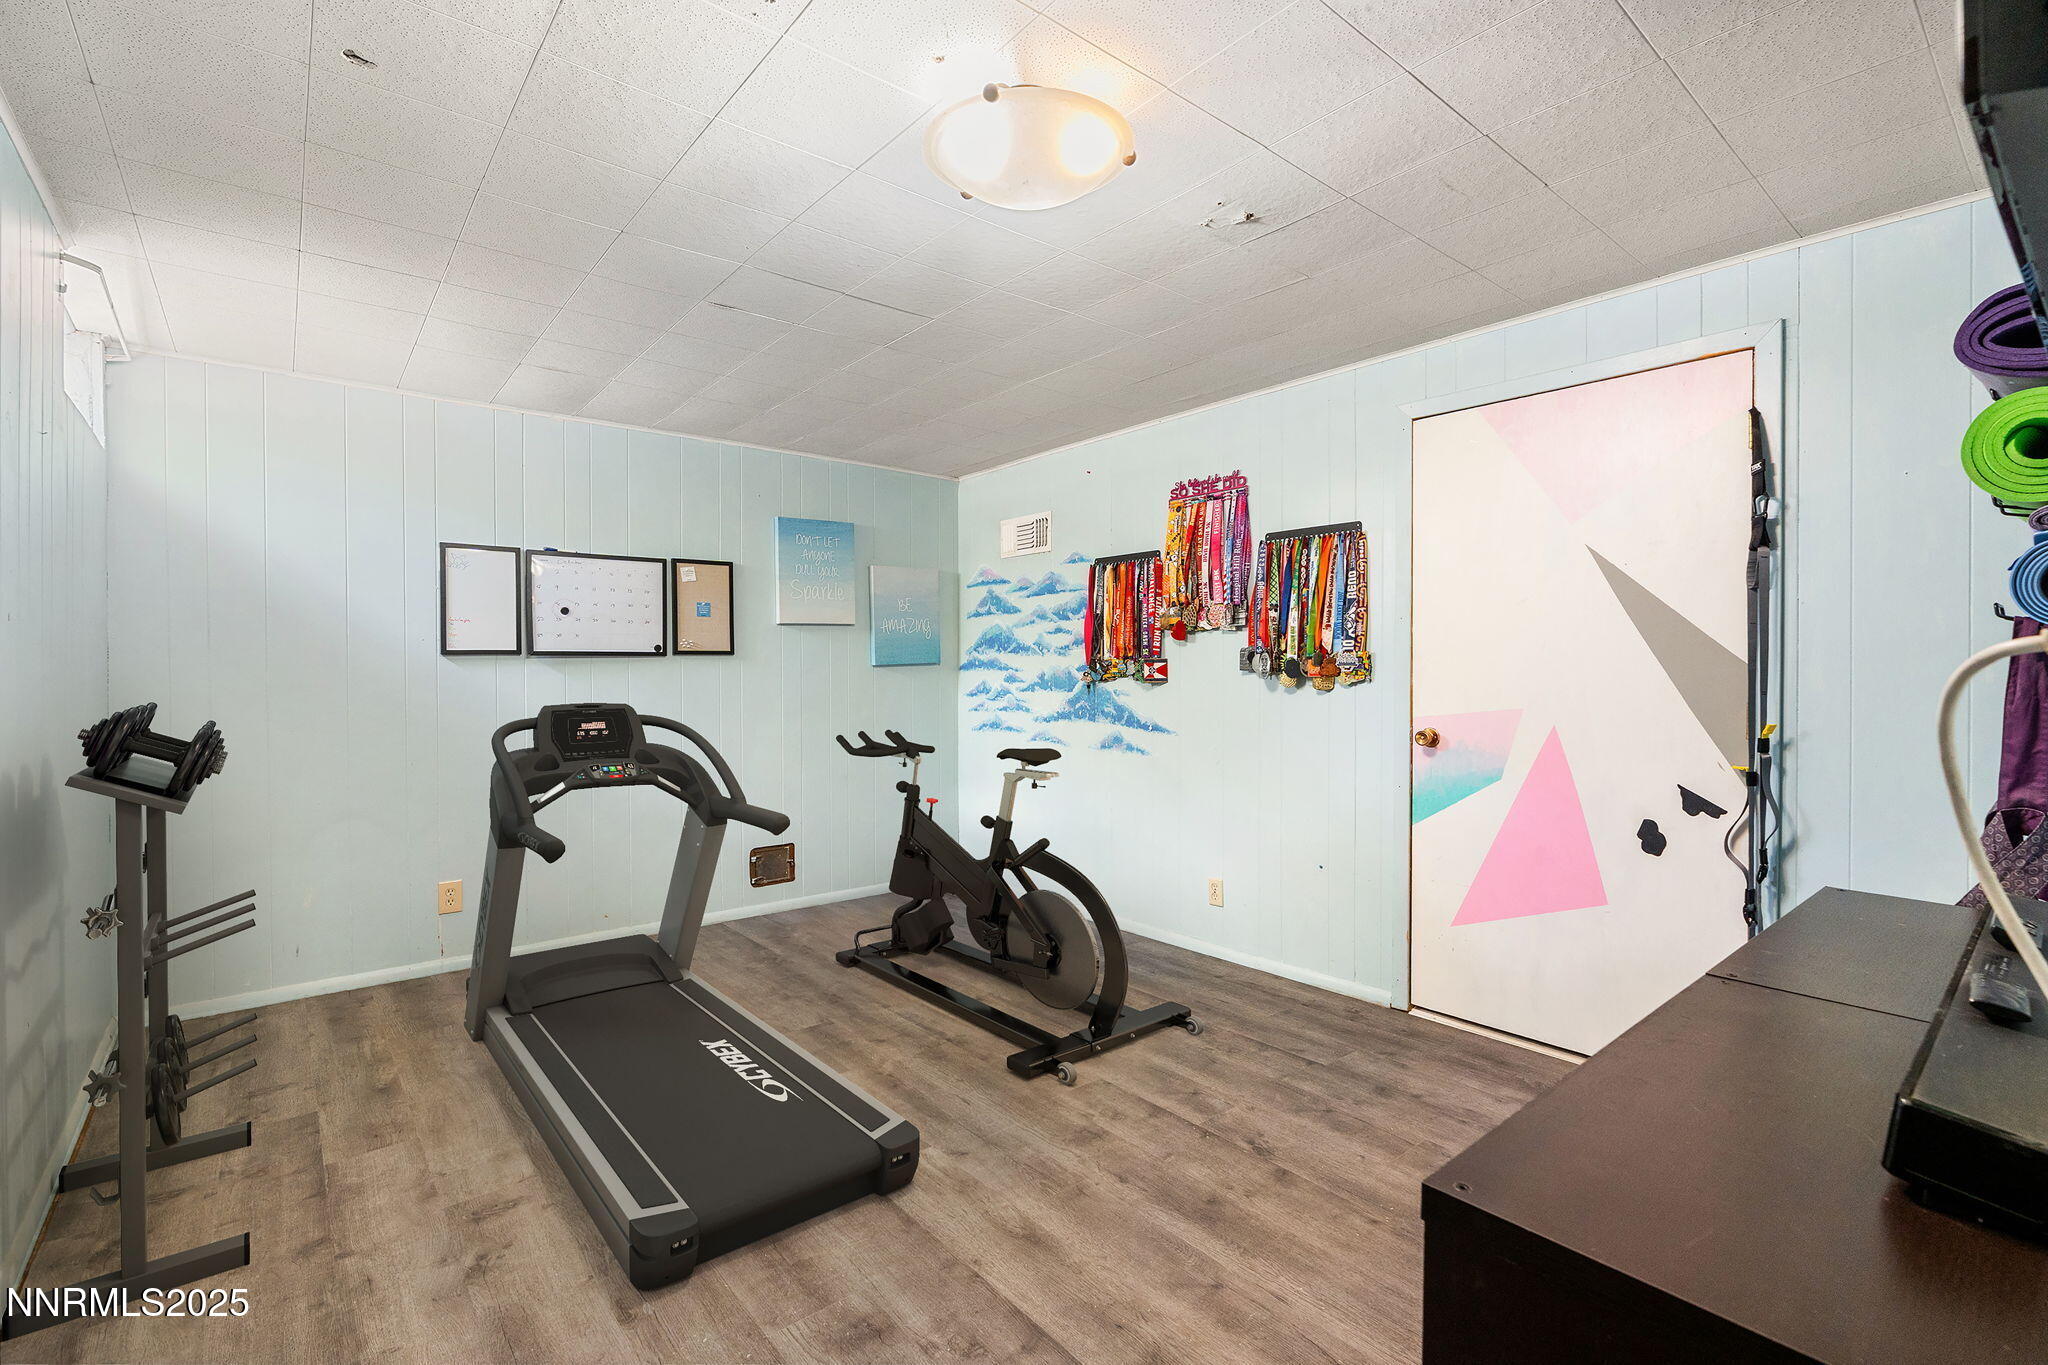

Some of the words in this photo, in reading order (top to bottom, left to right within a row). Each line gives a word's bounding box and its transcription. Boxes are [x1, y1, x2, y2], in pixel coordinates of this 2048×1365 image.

[1170, 488, 1188, 498] SO
[1192, 481, 1218, 495] SHE
[1223, 476, 1247, 489] DID
[824, 537, 840, 548] LET
[790, 579, 845, 603] Sparkle
[1347, 571, 1356, 599] RENO
[897, 597, 912, 612] BE
[1153, 630, 1161, 646] RUN
[1342, 640, 1354, 650] 10
[699, 1039, 773, 1081] CYBEX
